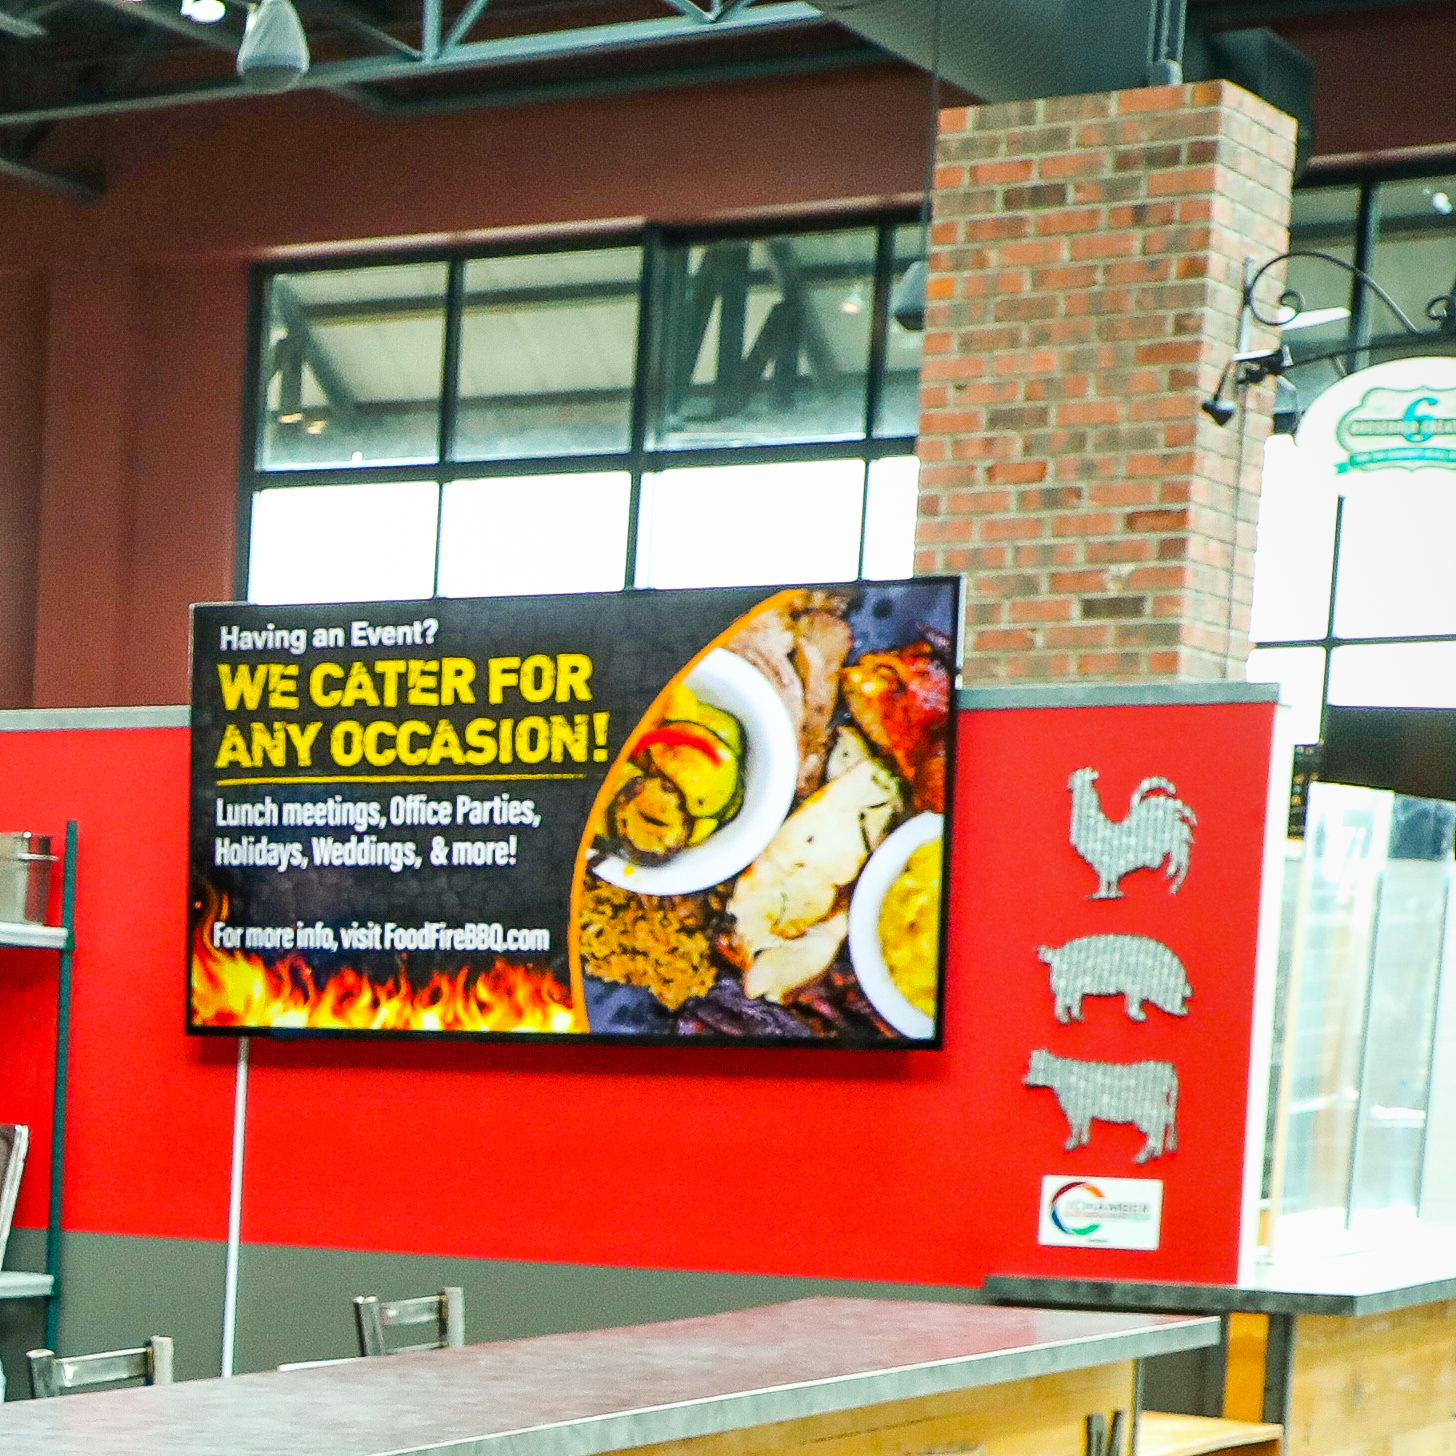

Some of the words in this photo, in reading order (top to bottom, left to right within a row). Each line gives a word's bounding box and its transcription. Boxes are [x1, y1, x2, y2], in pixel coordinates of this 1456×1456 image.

[220, 623, 307, 655] Having
[312, 627, 345, 648] an
[350, 618, 439, 647] Event?
[217, 663, 300, 711] WE
[309, 656, 477, 708] CATER
[489, 653, 593, 705] FOR
[214, 721, 322, 769] ANY
[330, 712, 611, 767] OCCASION!
[216, 796, 279, 828] Lunch
[282, 799, 387, 833] meetings,
[390, 794, 452, 825] Office
[457, 794, 542, 828] Parties,
[215, 835, 309, 873] Holidays,
[312, 836, 422, 872] Weddings,
[430, 837, 448, 864] &
[452, 835, 517, 866] more!
[213, 922, 242, 949] For
[245, 928, 292, 949] more
[296, 922, 339, 953] info,
[341, 923, 382, 950] visit
[384, 922, 550, 953] FoodFireBBQ.com
